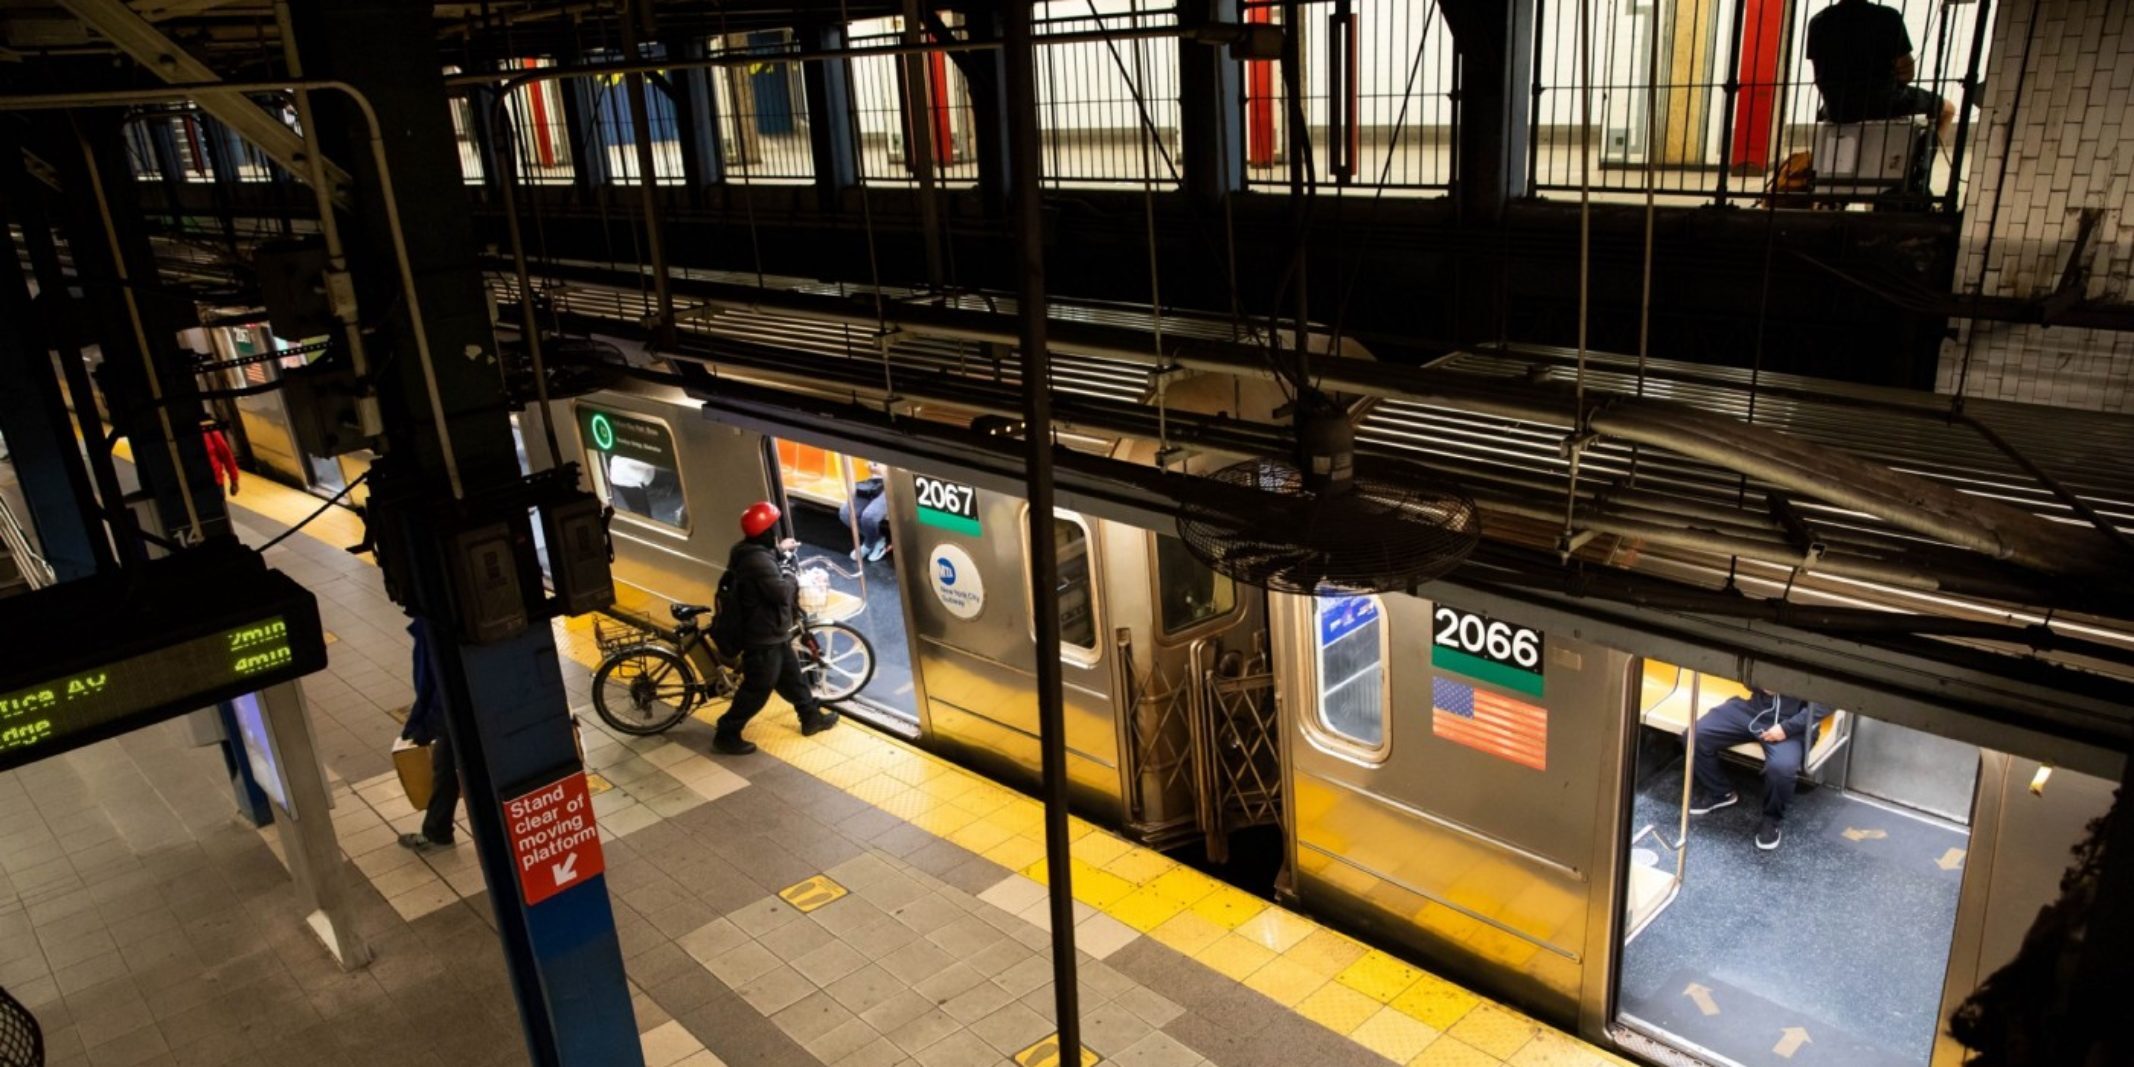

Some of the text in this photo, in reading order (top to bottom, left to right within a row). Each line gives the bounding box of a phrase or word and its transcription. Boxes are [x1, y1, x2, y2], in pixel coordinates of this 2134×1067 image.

[915, 476, 974, 516] 2067
[1435, 608, 1540, 667] 2066
[234, 647, 292, 674] 4min
[0, 719, 51, 751] dge
[510, 784, 565, 818] Stand
[515, 793, 584, 834] clear of
[519, 814, 584, 852] moving
[522, 826, 597, 871] platform
